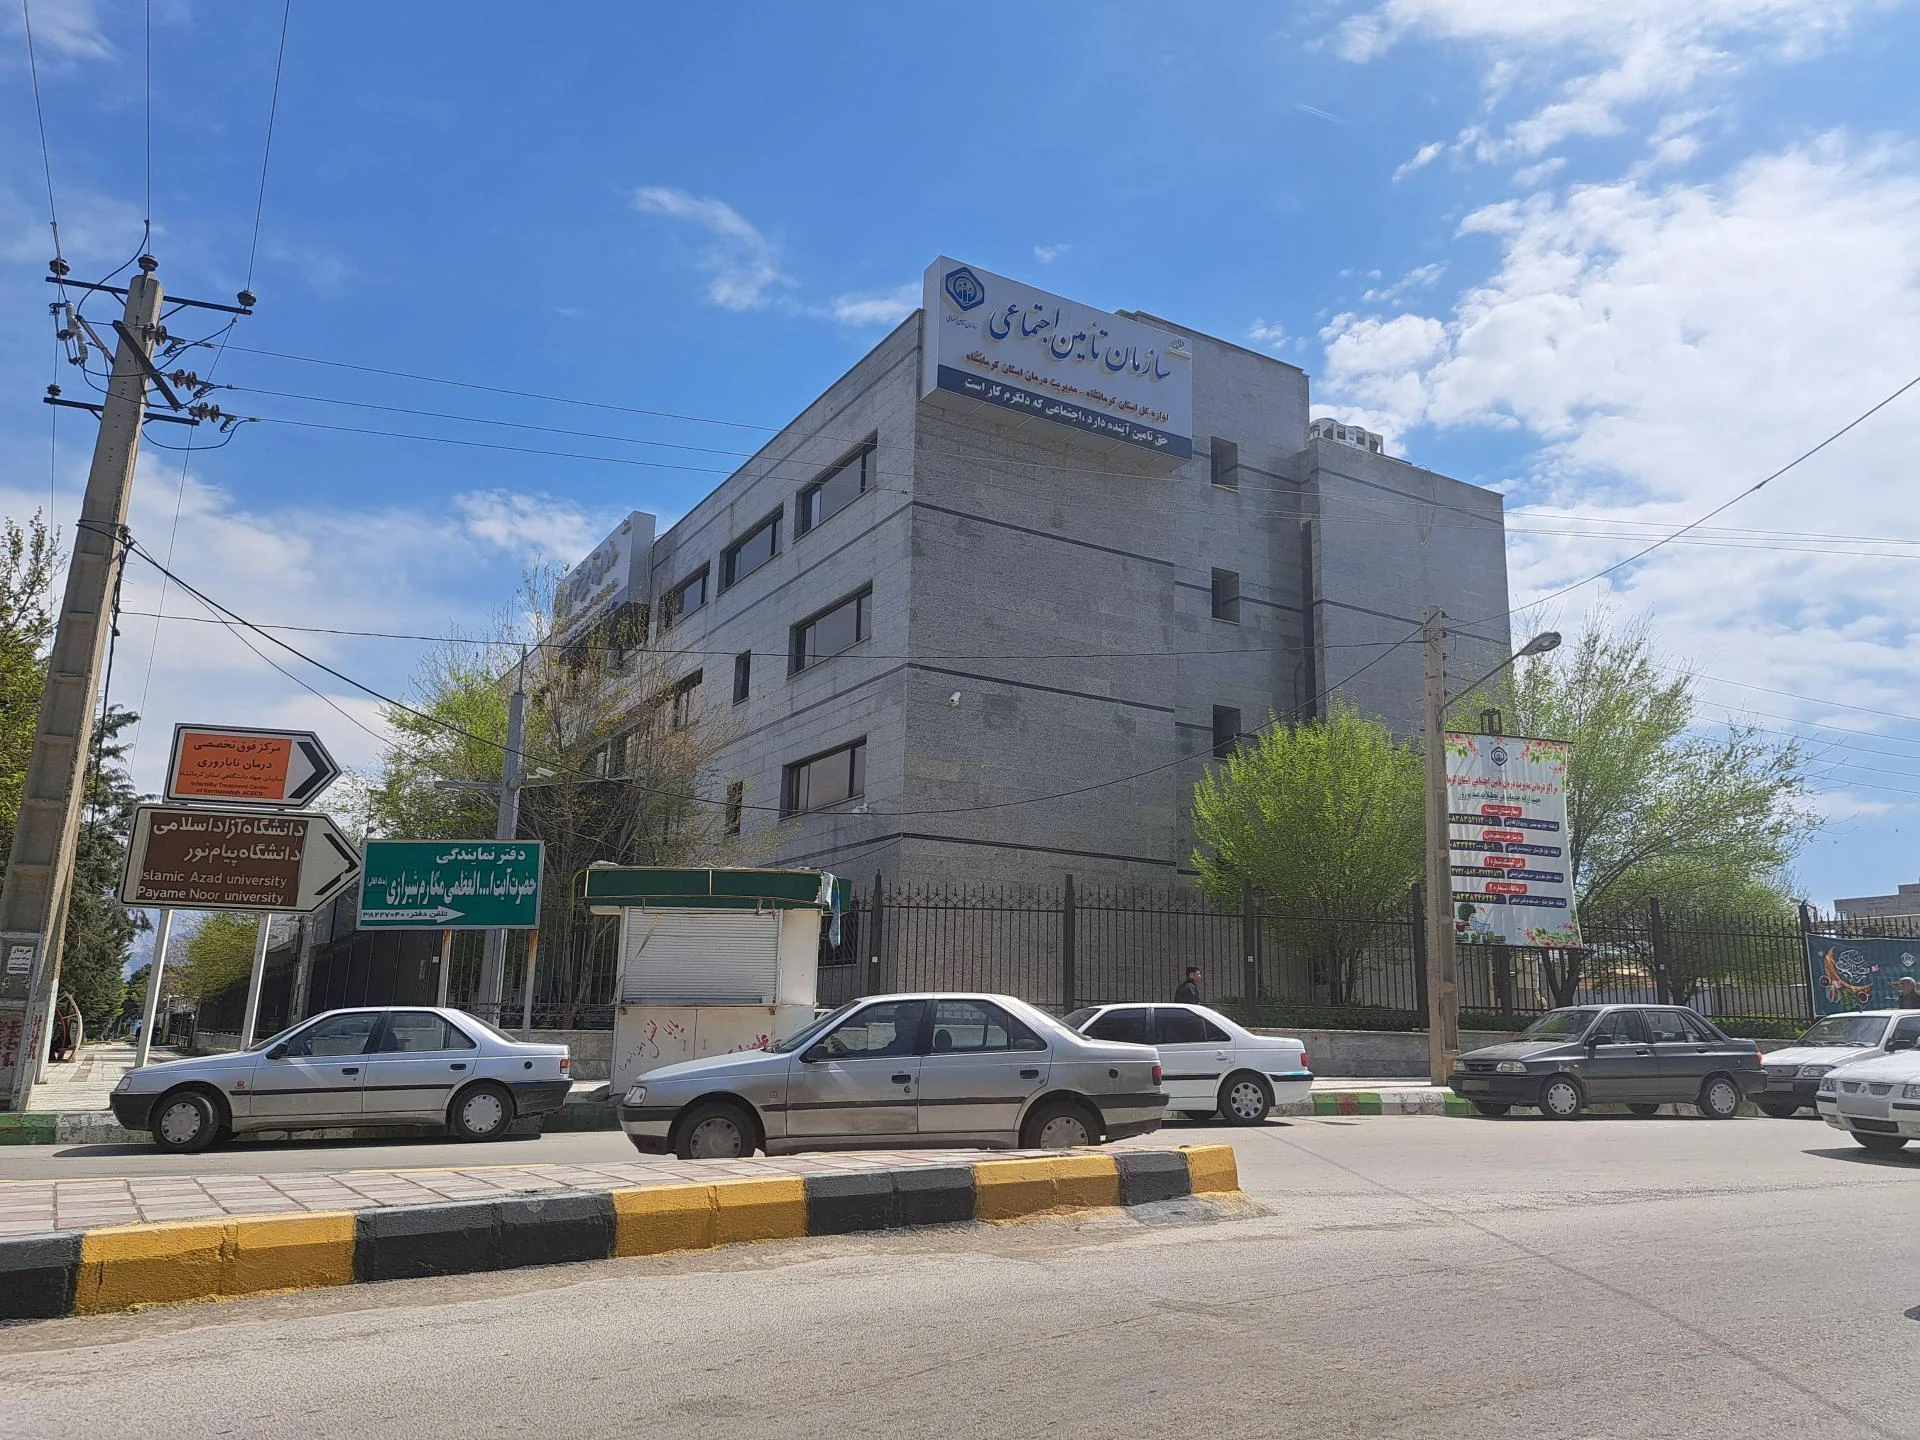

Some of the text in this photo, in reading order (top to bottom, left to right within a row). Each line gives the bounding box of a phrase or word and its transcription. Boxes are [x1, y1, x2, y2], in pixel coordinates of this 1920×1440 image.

[989, 303, 1060, 344] اجتماعی
[966, 350, 1000, 370] کرمانشاه
[1105, 345, 1171, 380] سازمان
[1001, 363, 1023, 376] استان
[1024, 370, 1048, 385] درمان
[964, 378, 985, 392] است
[988, 384, 1002, 397] کار
[1050, 378, 1078, 394] مدیریت
[1032, 399, 1044, 409] که
[1086, 388, 1117, 407] کرمانشاه
[1118, 400, 1138, 412] استان
[1139, 405, 1149, 416] کل
[1086, 415, 1106, 428] دارد
[1150, 410, 1169, 421] اداره
[1107, 422, 1131, 436] آینده
[1154, 434, 1169, 446] حق
[193, 739, 281, 755] مرکز فوق تخصصی
[197, 757, 273, 770] درمان ناباروری
[153, 816, 305, 839] دانشگاه آزاد اسلامی
[184, 842, 301, 867] دانشگاه پیام نور
[435, 845, 526, 865] دفتر نمایندگی
[140, 870, 288, 889] Islamic Azad university
[386, 869, 419, 906] شیرازی
[443, 868, 481, 904] العظمی
[493, 867, 513, 901] آیت
[137, 886, 284, 905] Payame Noor university
[509, 871, 537, 905] حضرت
[429, 910, 448, 919] تلفن
